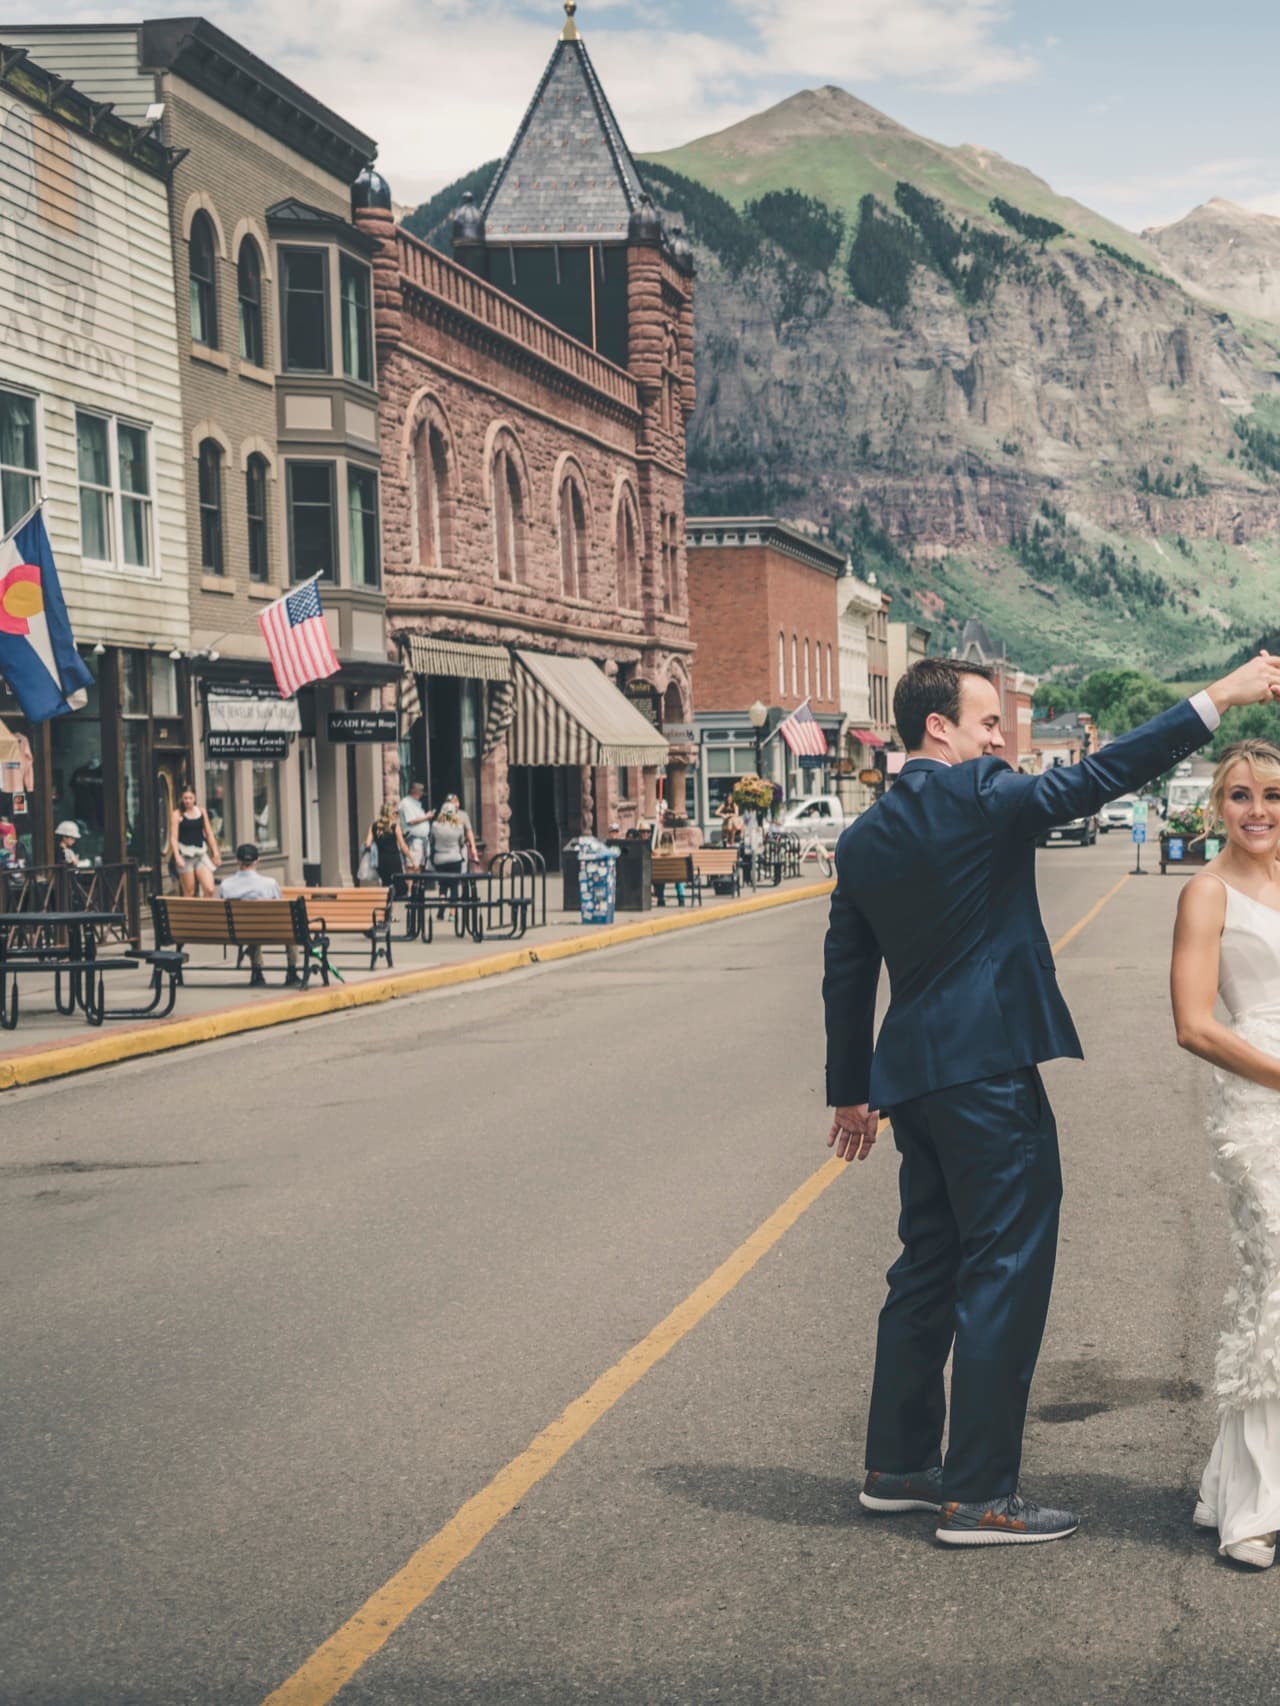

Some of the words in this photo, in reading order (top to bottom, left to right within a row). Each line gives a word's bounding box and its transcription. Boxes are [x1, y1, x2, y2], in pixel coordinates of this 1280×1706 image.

[330, 719, 359, 728] AZADI
[361, 719, 377, 728] Fine
[209, 737, 240, 746] BELLA
[241, 736, 258, 746] Fine
[259, 736, 285, 746] Goods
